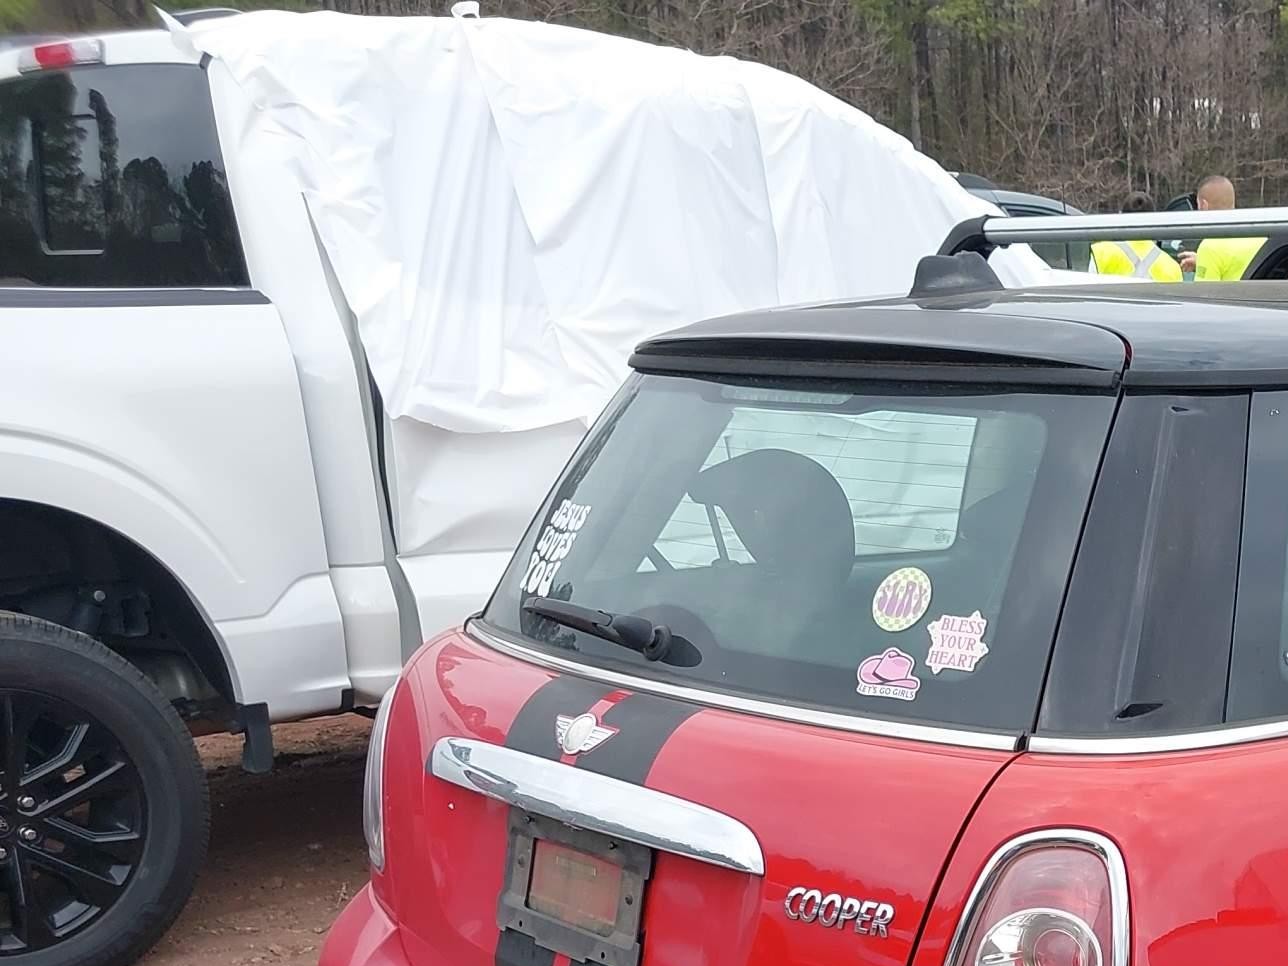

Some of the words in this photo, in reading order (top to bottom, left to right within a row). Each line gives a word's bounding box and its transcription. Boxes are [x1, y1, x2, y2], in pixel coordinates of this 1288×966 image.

[550, 499, 592, 531] JESUS
[537, 526, 577, 562] LOVES
[519, 551, 562, 598] YOU
[877, 580, 928, 618] SLAY
[939, 634, 977, 651] YOUR
[941, 617, 985, 636] BLESS
[929, 650, 978, 668] HEART
[858, 684, 878, 694] LET'S
[879, 687, 892, 695] GO
[892, 688, 914, 699] GIRLS
[784, 885, 896, 938] COOPER
